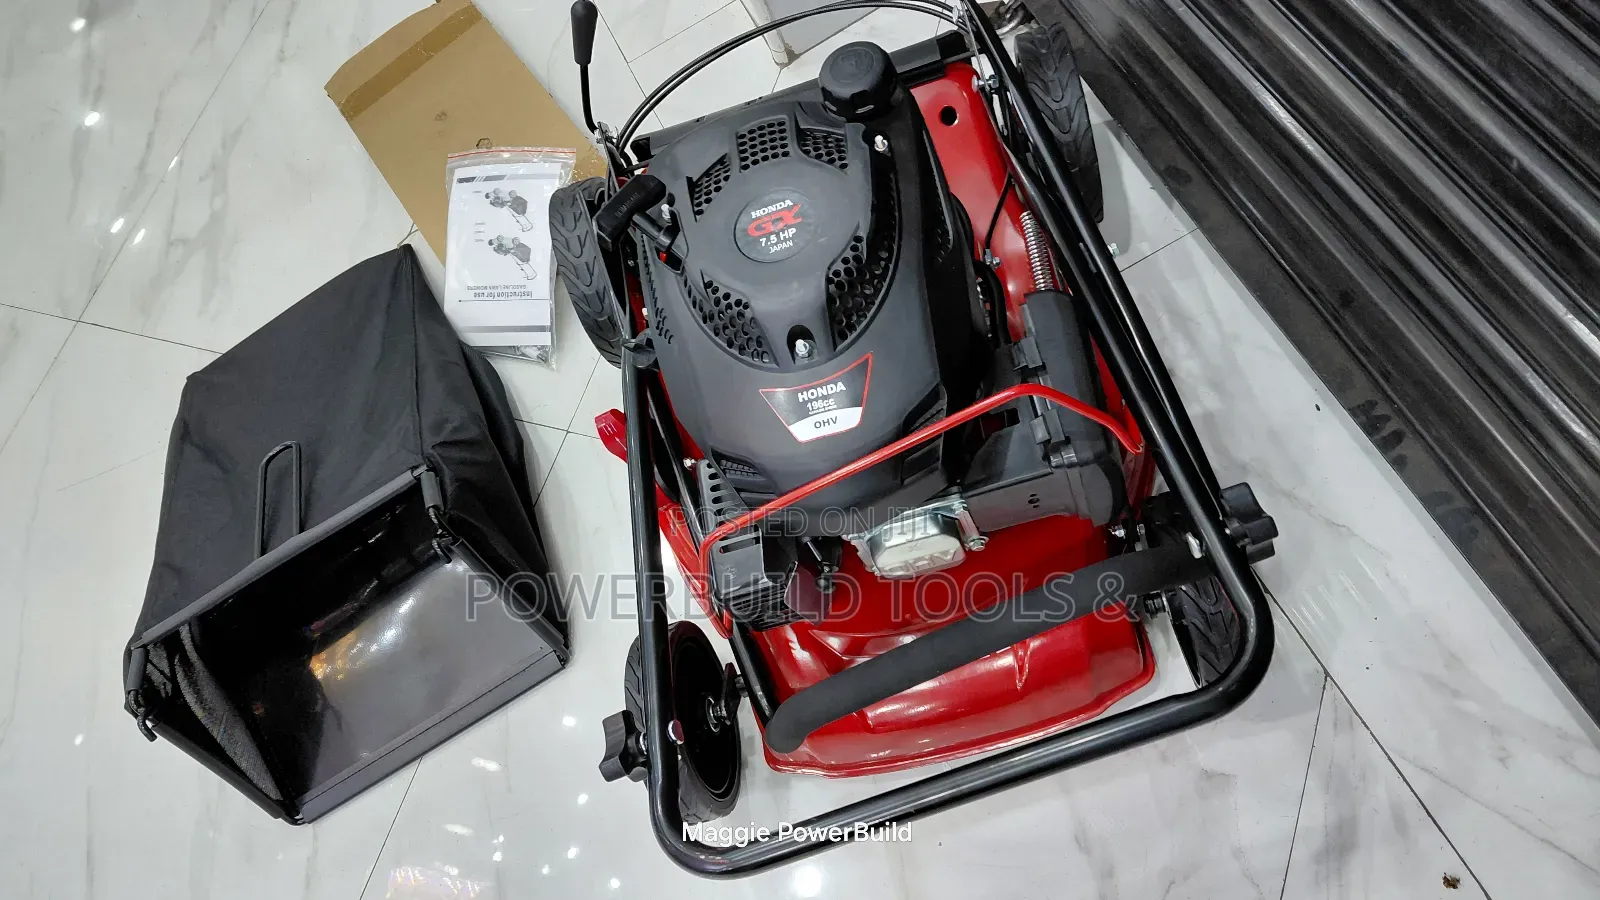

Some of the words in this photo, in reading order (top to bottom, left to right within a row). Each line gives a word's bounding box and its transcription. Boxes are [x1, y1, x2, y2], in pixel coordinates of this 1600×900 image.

[751, 199, 793, 219] HONDA
[747, 202, 803, 237] GX
[760, 234, 778, 247] 7.5
[779, 227, 797, 241] HP
[769, 240, 793, 254] JAPAN
[496, 290, 533, 298] Instruction
[797, 381, 846, 403] HONDA
[806, 398, 836, 412] 196cc
[814, 416, 838, 429] OHV
